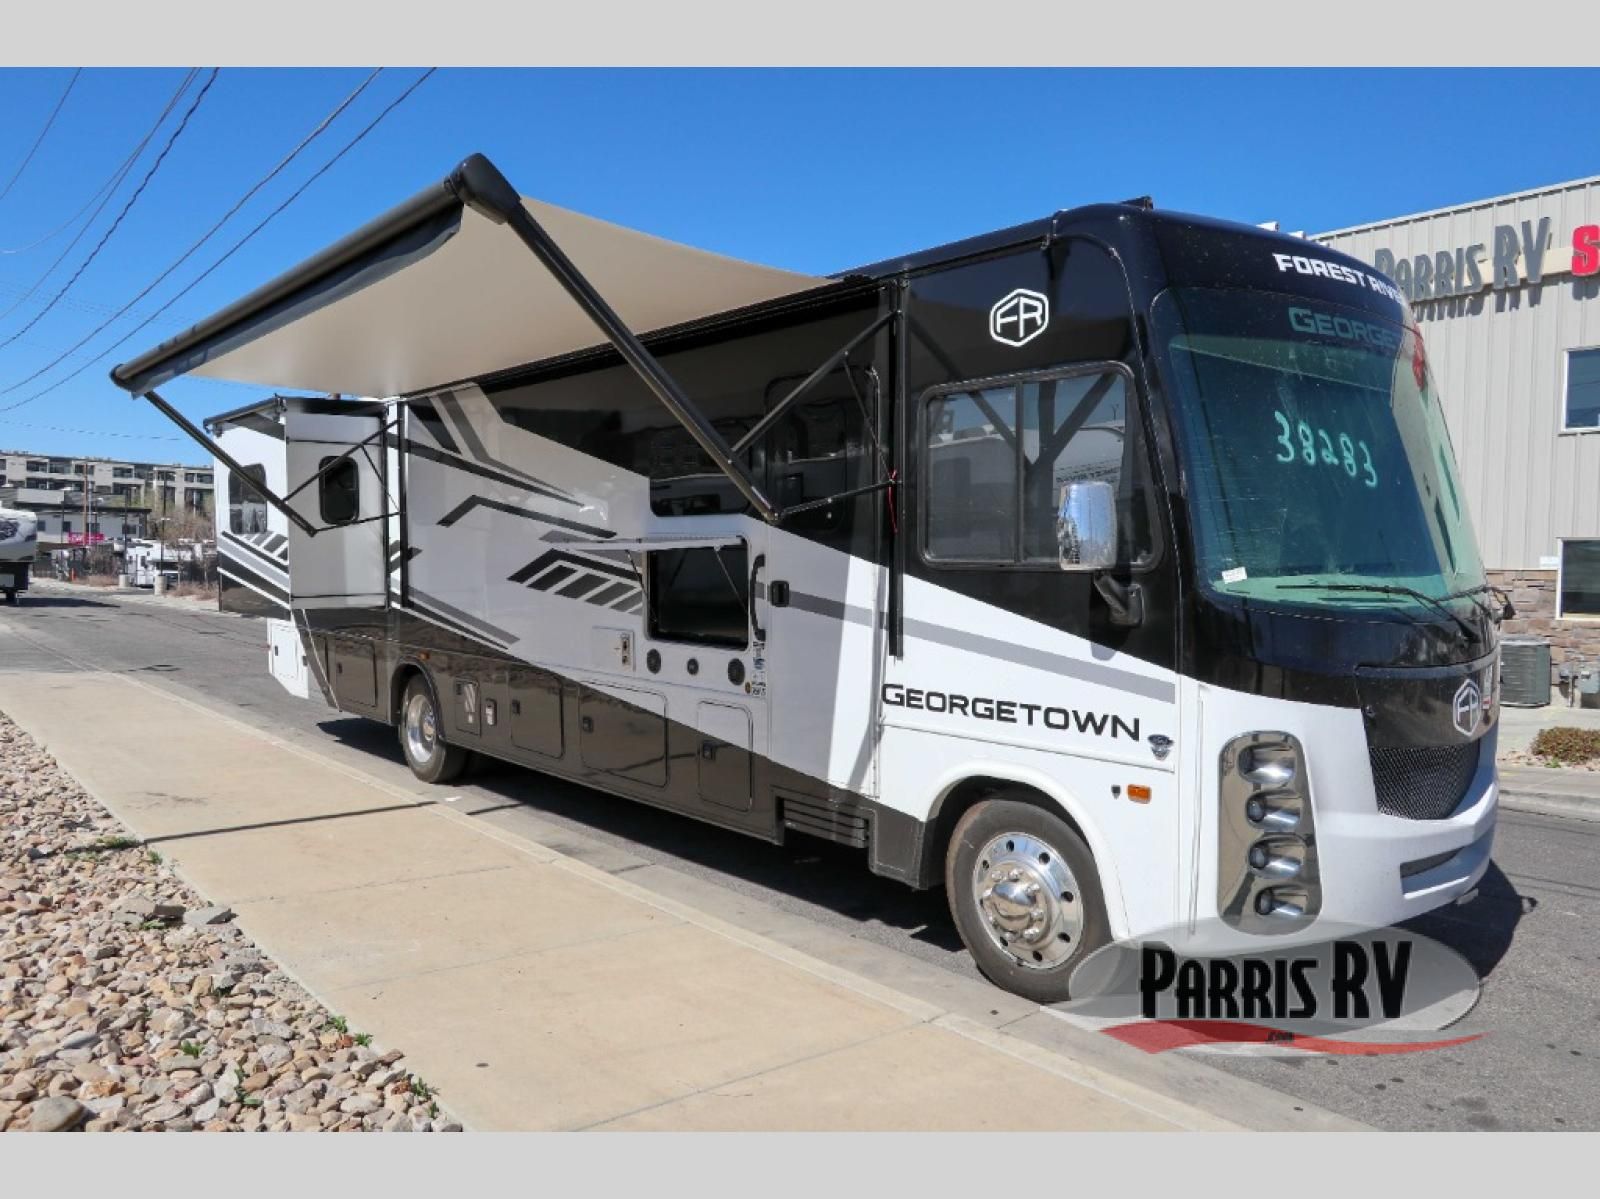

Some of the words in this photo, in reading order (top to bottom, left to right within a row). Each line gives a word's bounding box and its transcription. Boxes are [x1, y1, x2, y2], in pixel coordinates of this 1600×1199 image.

[1272, 252, 1367, 287] FOREST
[1494, 217, 1550, 288] RV
[1274, 410, 1378, 488] 38283
[881, 683, 1140, 742] GEORGETOWN
